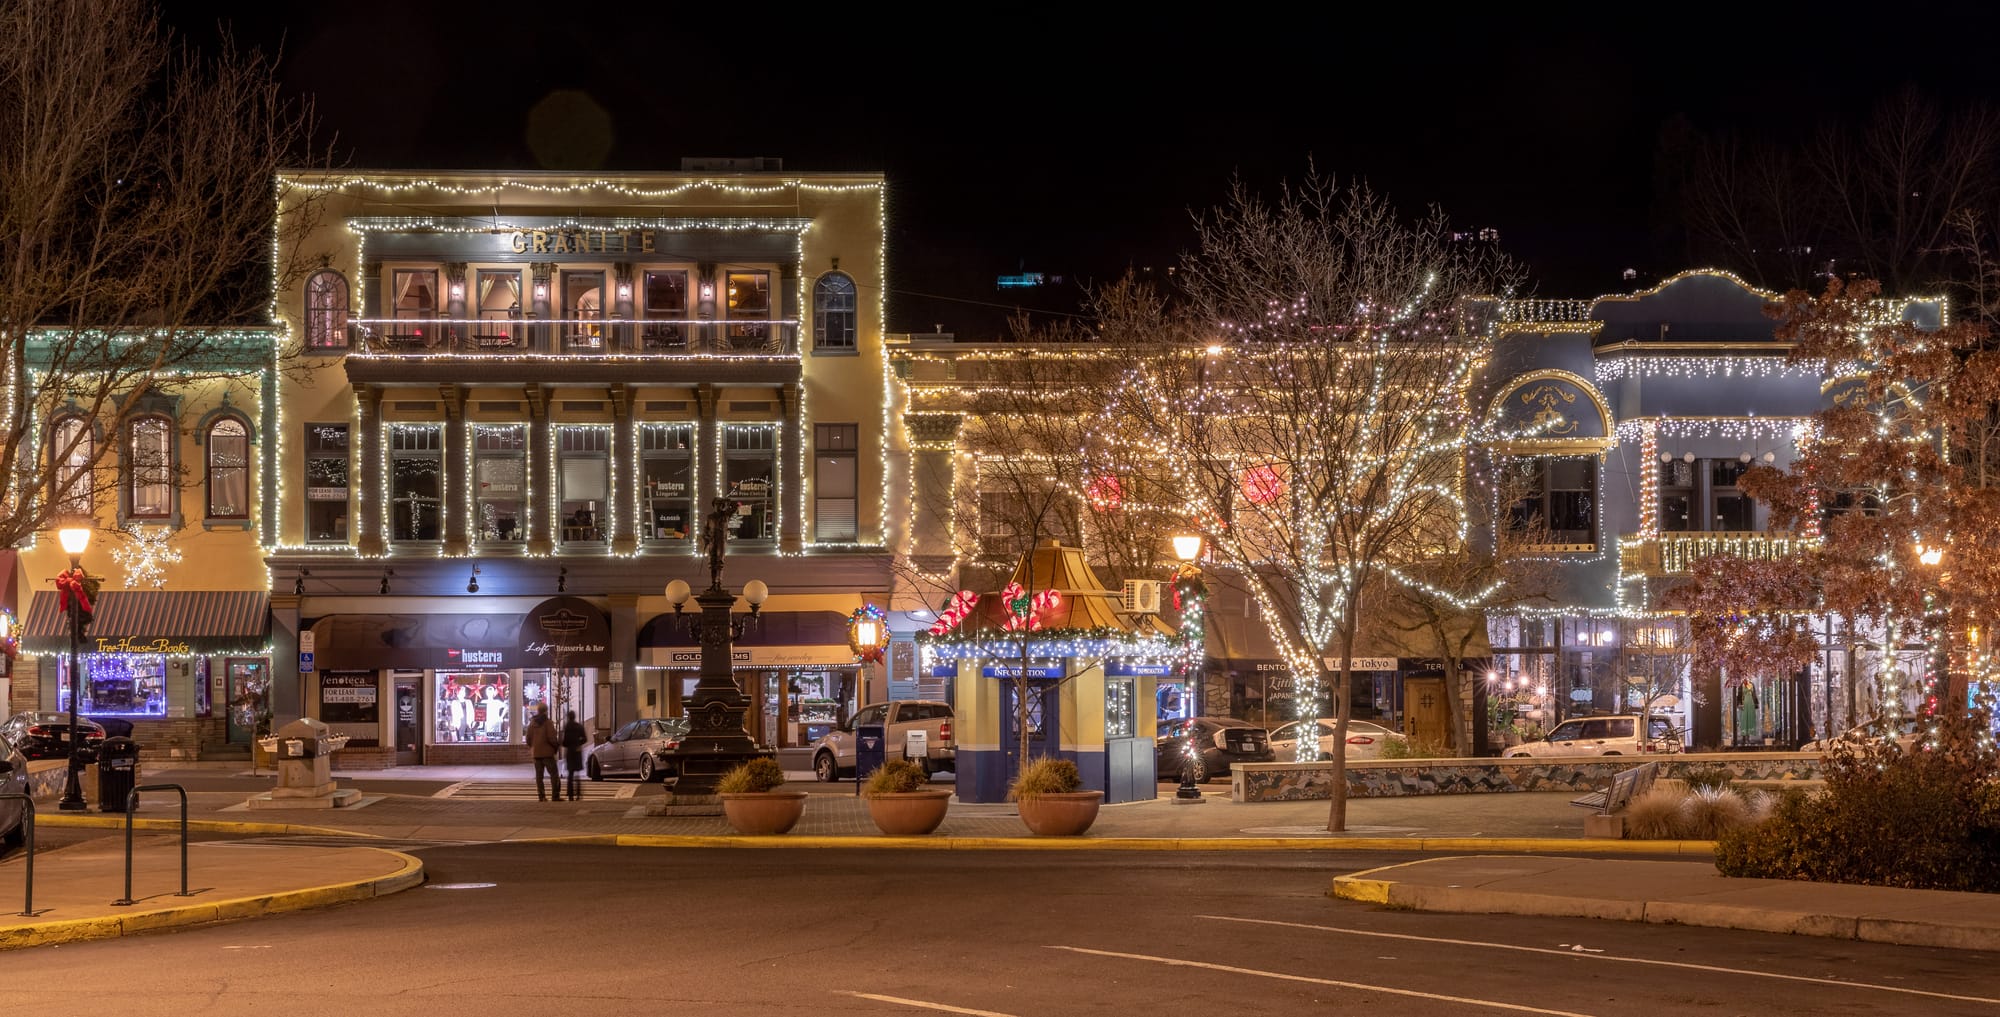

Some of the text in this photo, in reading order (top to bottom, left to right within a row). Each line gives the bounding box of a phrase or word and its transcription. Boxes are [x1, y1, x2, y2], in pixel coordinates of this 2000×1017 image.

[511, 231, 656, 253] GRANITE
[96, 636, 189, 654] Tree House Books
[524, 642, 555, 656] Loft
[1360, 659, 1389, 669] Tokyo
